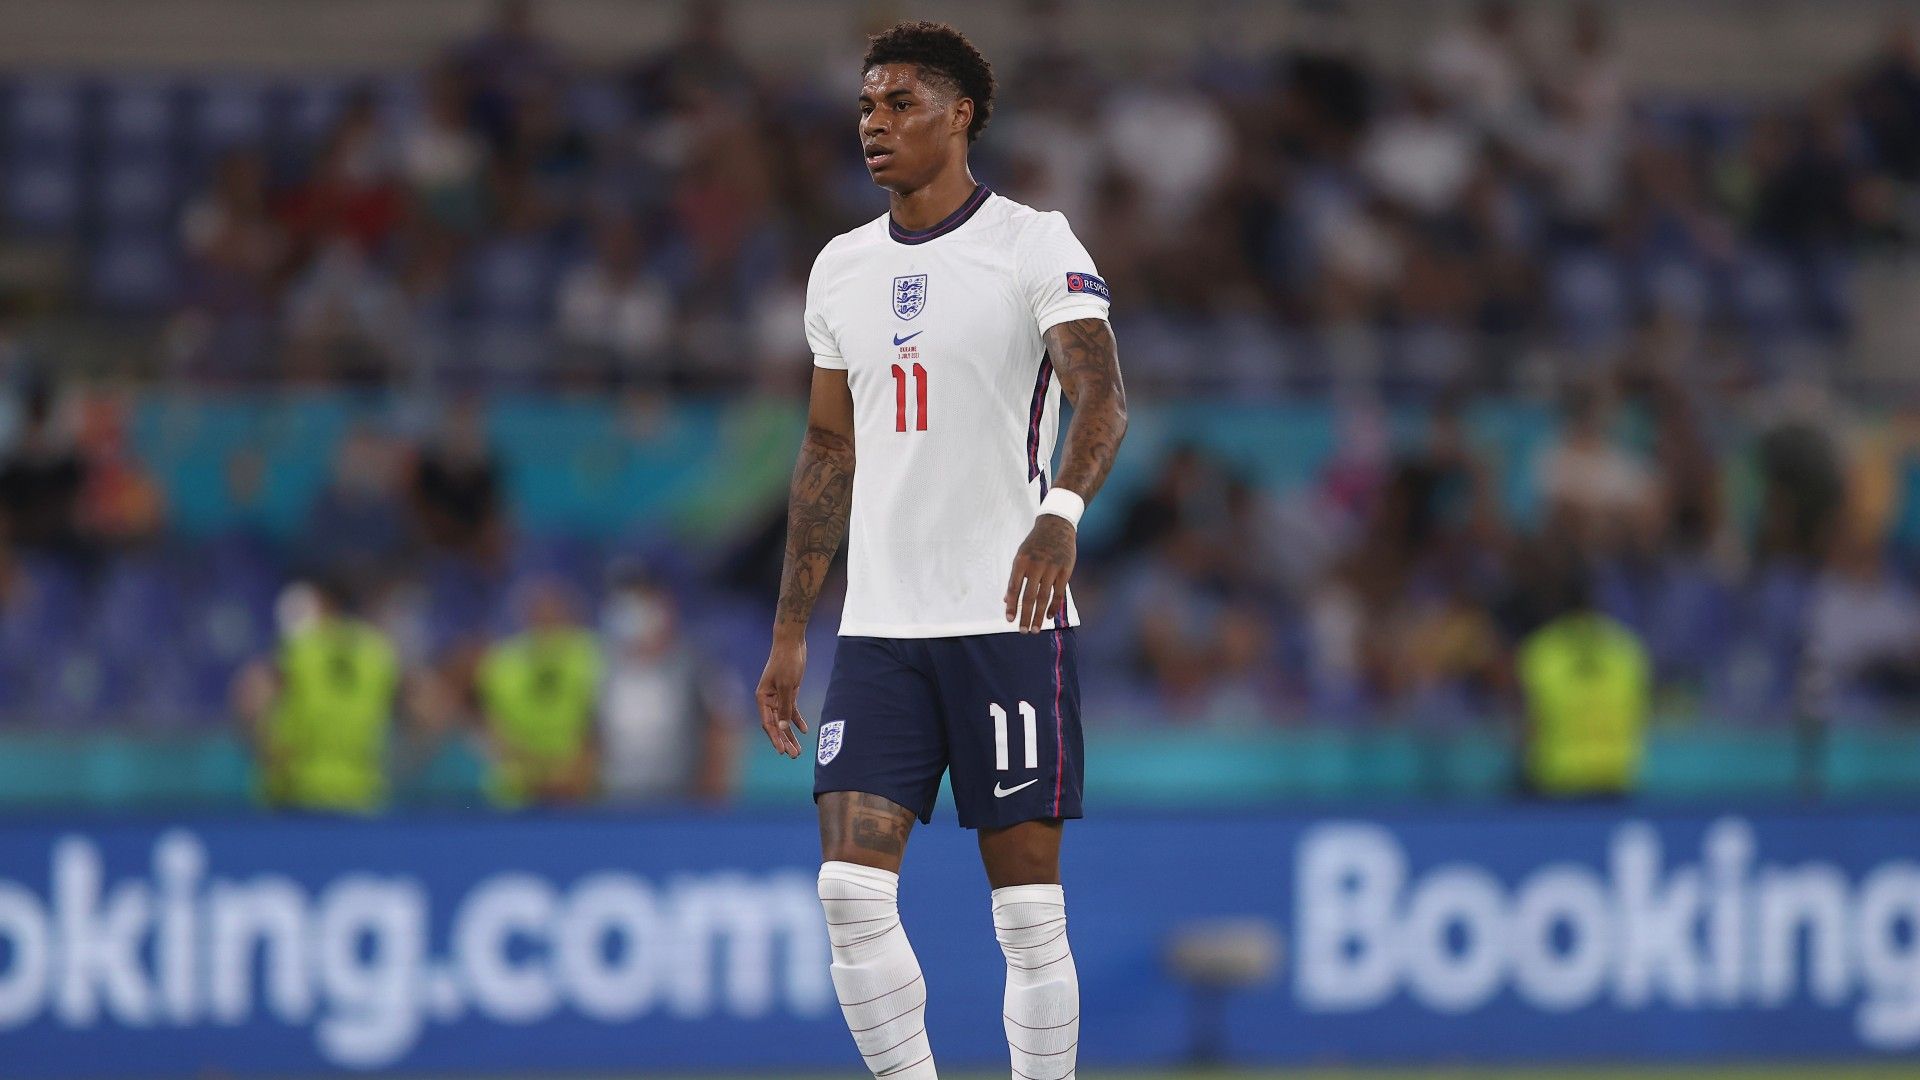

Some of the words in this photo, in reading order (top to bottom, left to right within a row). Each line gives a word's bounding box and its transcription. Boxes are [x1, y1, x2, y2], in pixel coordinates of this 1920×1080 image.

[891, 362, 928, 432] 11
[989, 700, 1038, 770] 11
[1294, 816, 1920, 1050] Booking
